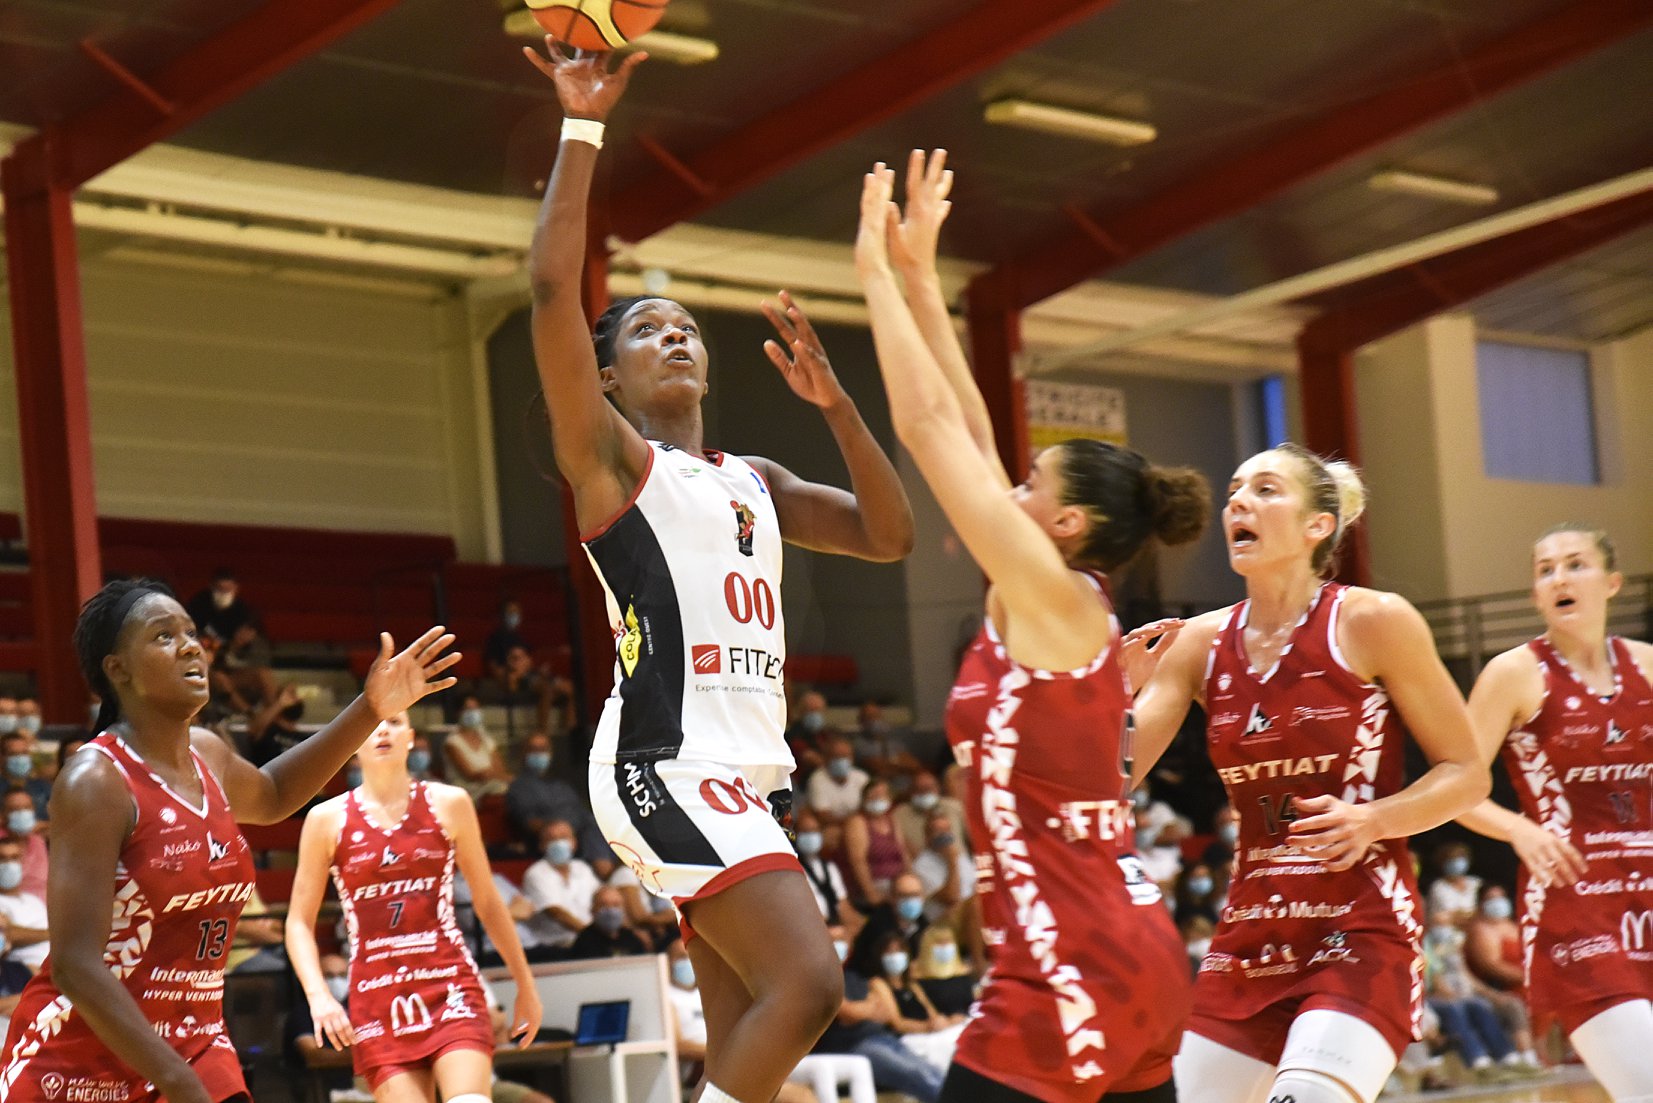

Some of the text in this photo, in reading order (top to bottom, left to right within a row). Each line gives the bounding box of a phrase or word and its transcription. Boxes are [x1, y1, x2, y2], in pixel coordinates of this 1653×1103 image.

[724, 571, 775, 631] 00
[163, 839, 202, 858] Nako
[162, 880, 256, 913] FEYTIA
[353, 876, 437, 902] FEYTIAT
[387, 901, 404, 929] 7
[195, 917, 230, 961] 13
[142, 989, 184, 1000] HYPER
[66, 1086, 130, 1102] ENERGIES
